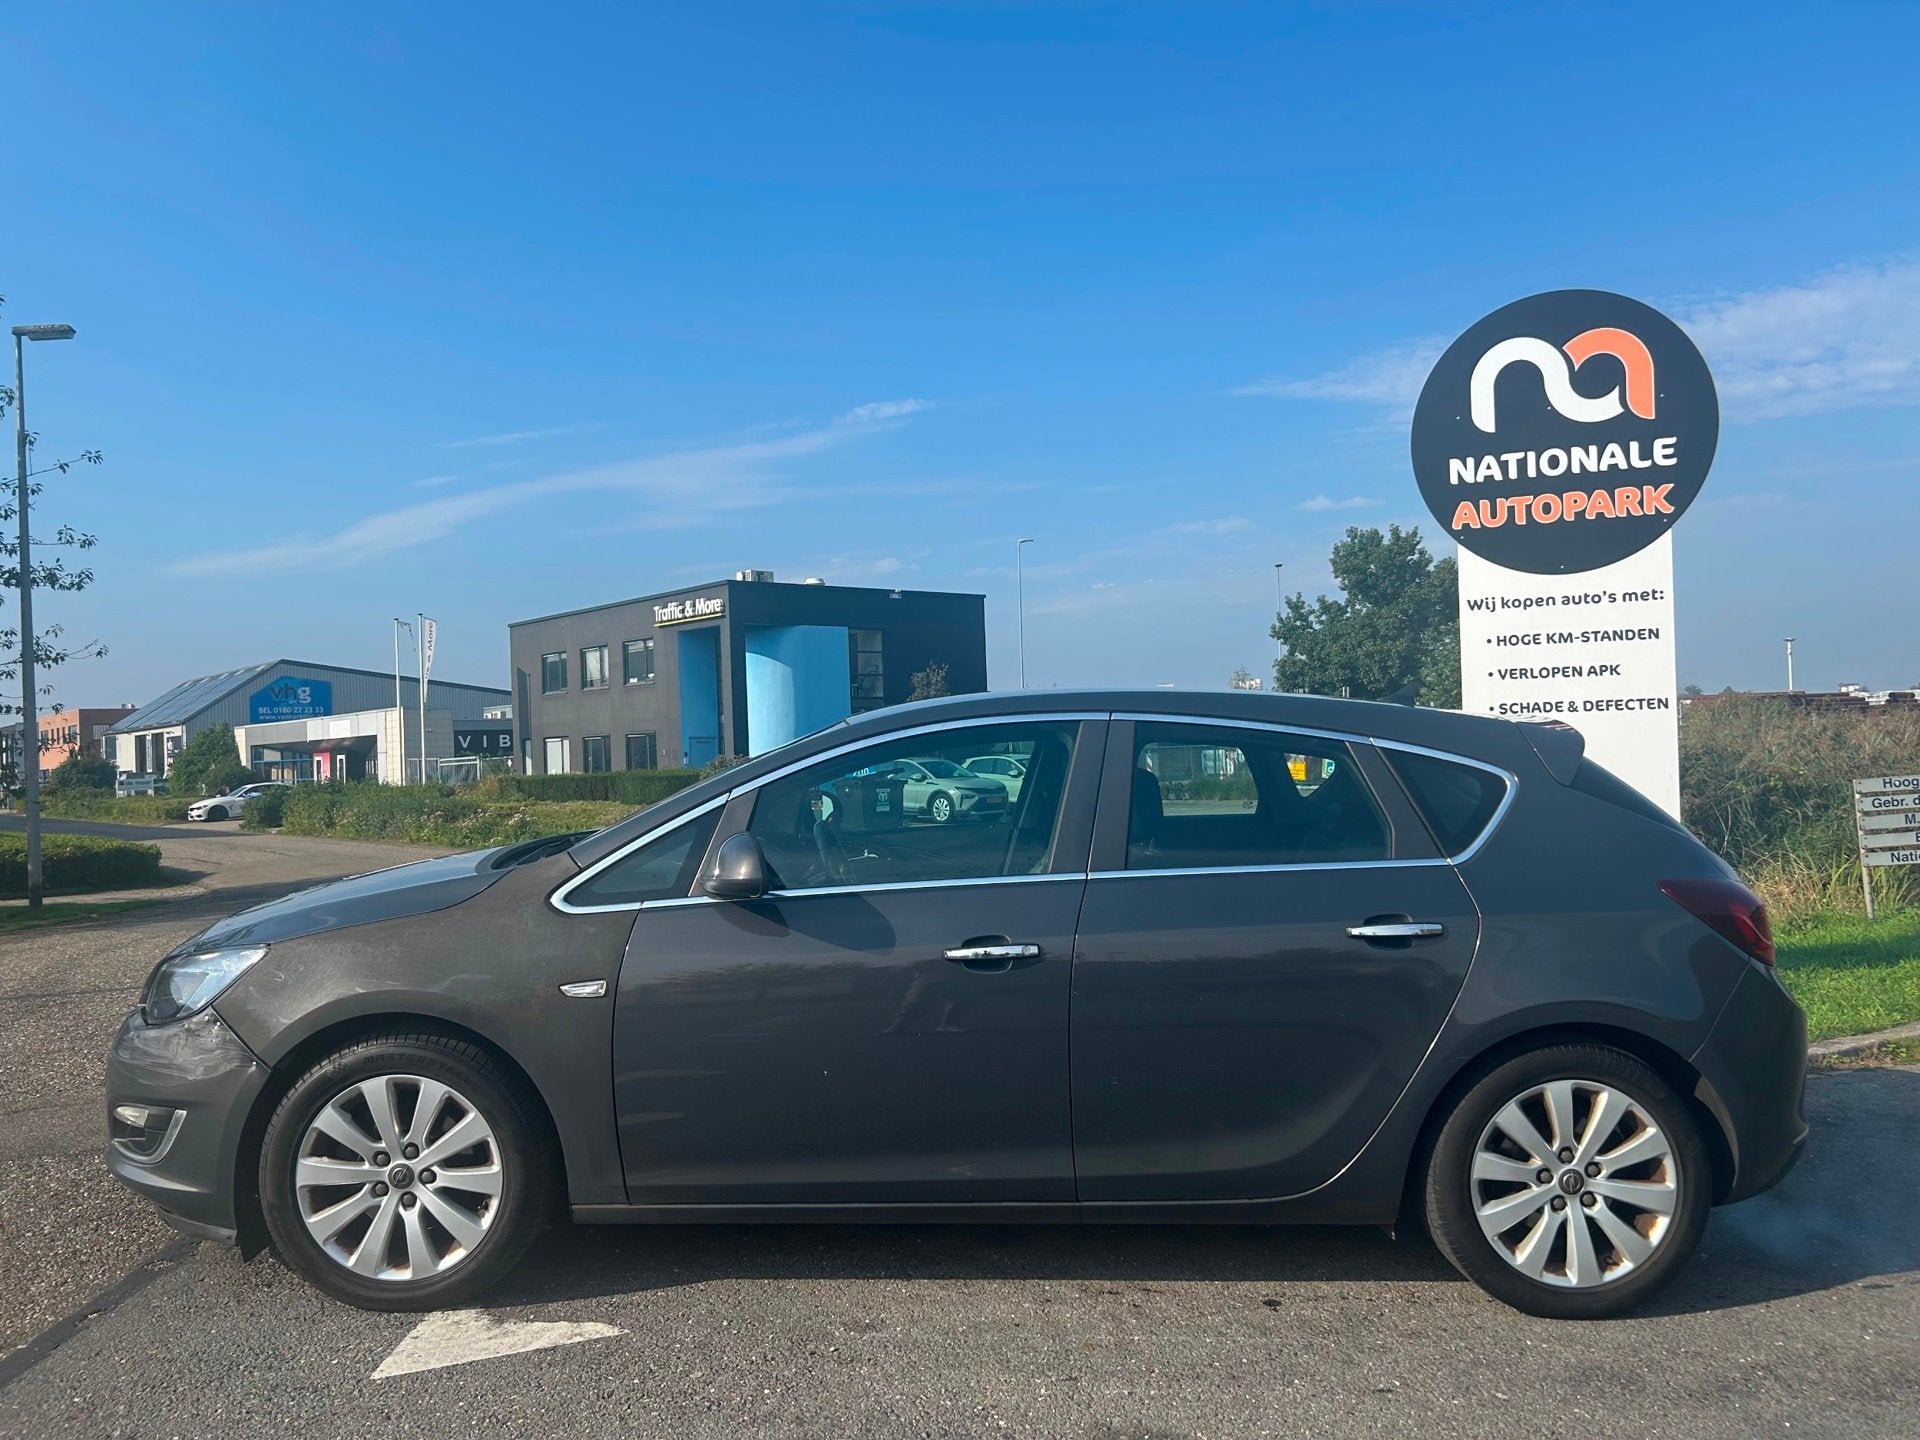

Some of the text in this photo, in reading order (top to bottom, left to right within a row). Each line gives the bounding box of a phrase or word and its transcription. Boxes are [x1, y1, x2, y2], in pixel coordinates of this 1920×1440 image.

[1449, 437, 1678, 485] NATIONALE
[1452, 483, 1675, 530] AUTOPARK
[1467, 588, 1665, 612] Wij kopen auto's met:
[653, 597, 723, 622] Traffic & More
[1496, 628, 1660, 647] HOGE KM-STANDEN
[1497, 664, 1621, 680] VERLOPEN APK
[270, 683, 312, 704] vhg
[258, 706, 272, 714] BEL
[1499, 697, 1669, 715] SCHADE & DEFECTEN
[458, 735, 511, 749] VIB
[1883, 777, 1920, 789] Hoog
[1872, 797, 1909, 808] Gebr.
[1891, 851, 1920, 863] Nati
